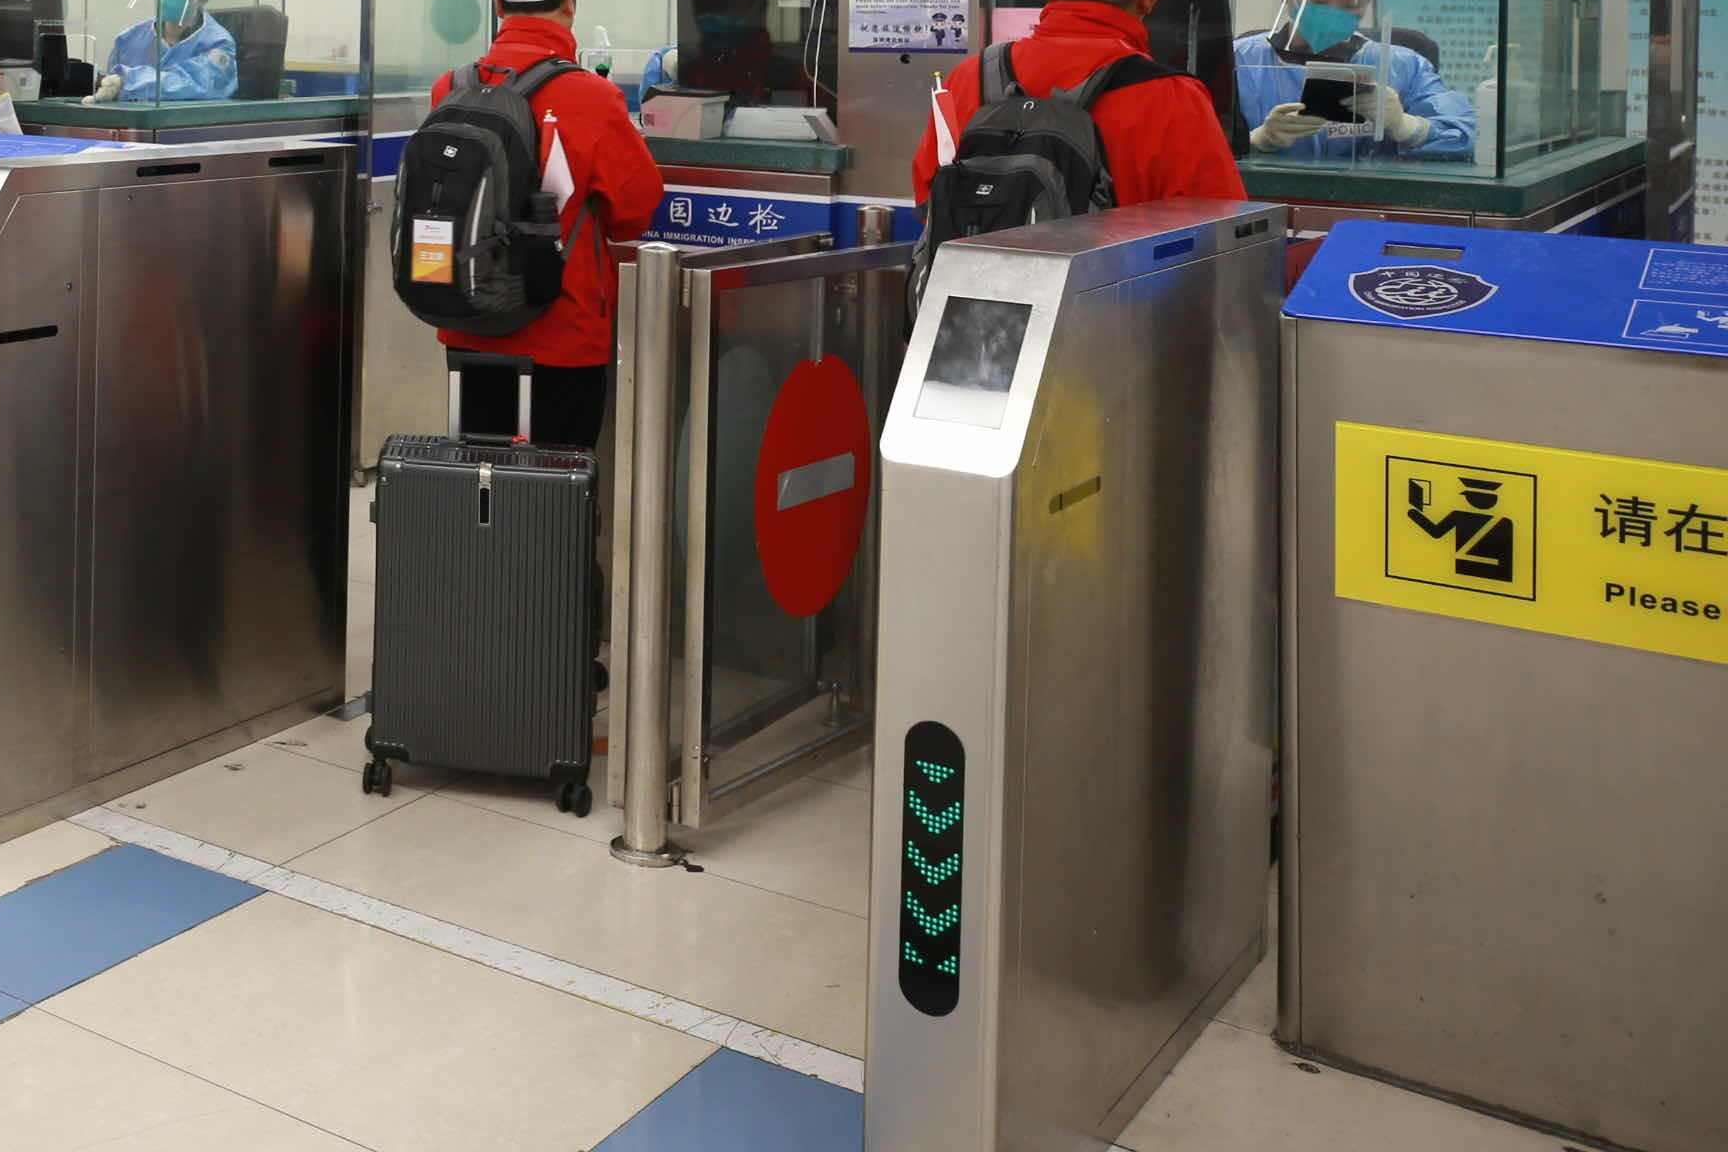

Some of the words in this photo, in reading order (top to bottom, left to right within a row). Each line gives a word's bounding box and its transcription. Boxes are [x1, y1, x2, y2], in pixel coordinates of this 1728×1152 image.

[1328, 123, 1374, 137] POLIC
[669, 197, 786, 235] 国边检
[663, 232, 724, 245] IMMIGRATION
[1594, 492, 1728, 556] 请在
[1605, 581, 1721, 620] Please
